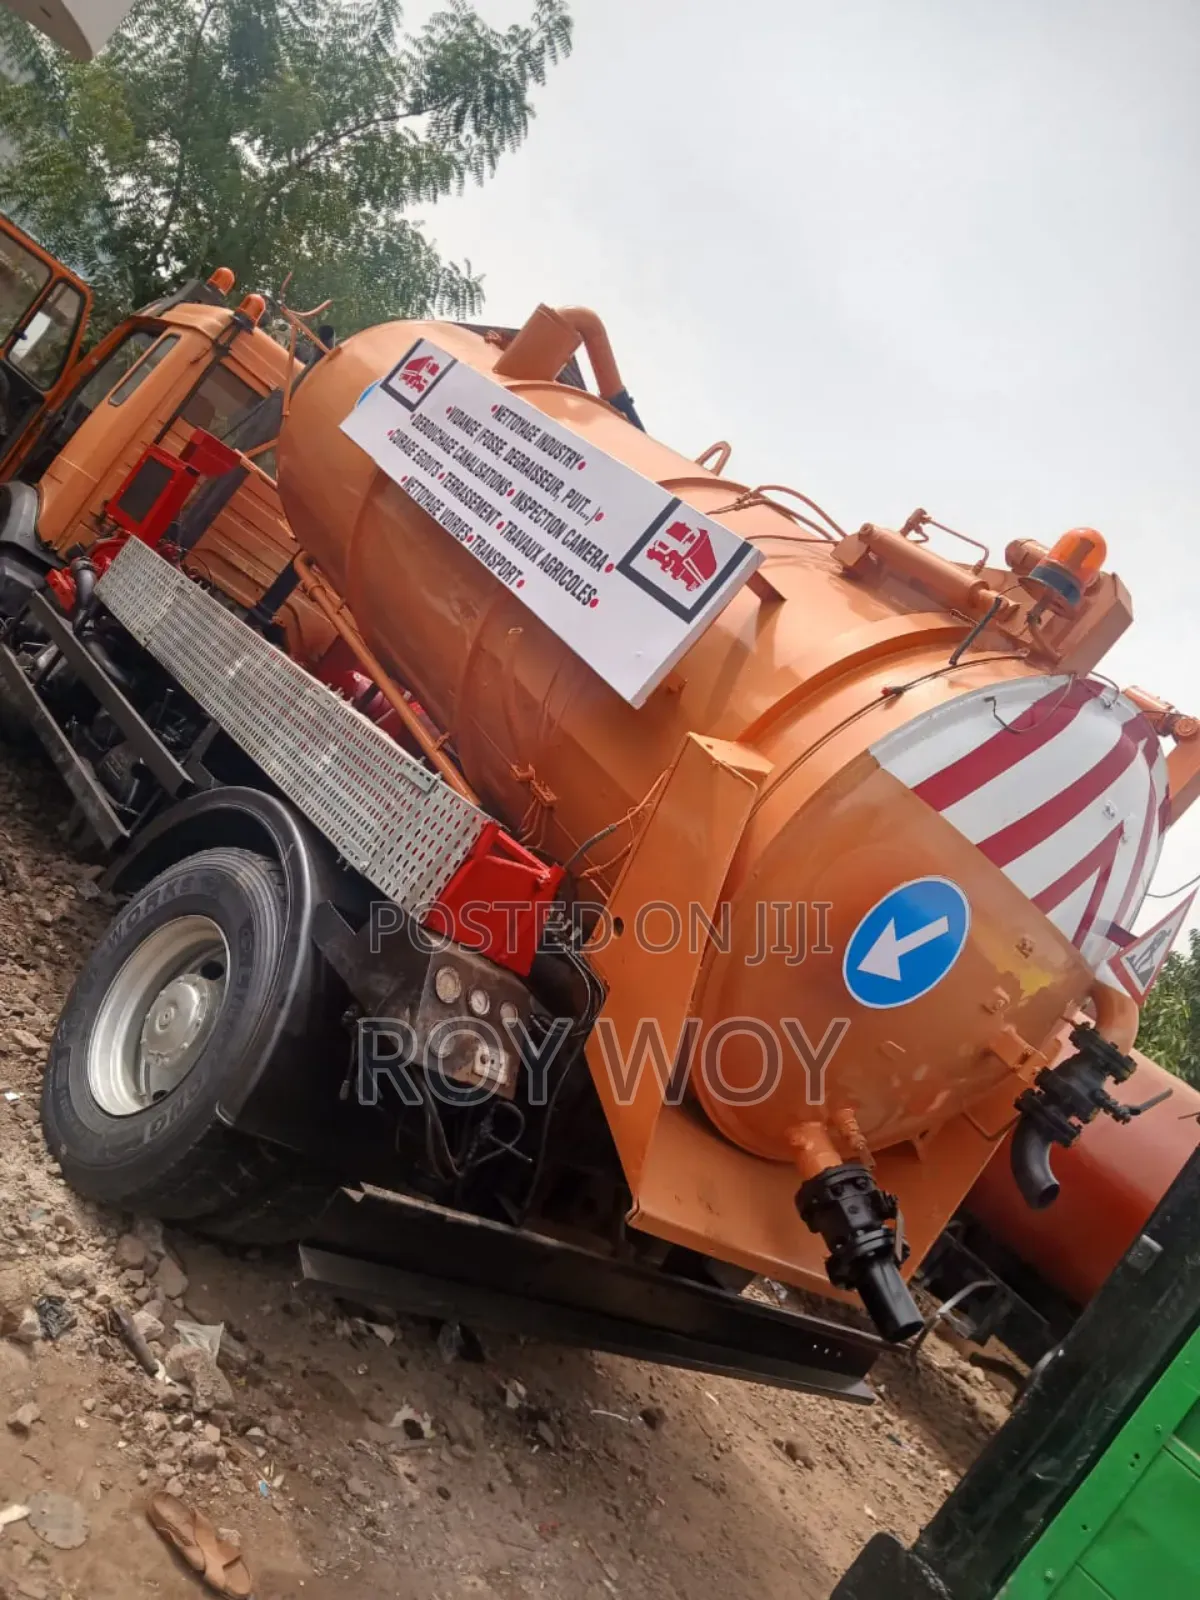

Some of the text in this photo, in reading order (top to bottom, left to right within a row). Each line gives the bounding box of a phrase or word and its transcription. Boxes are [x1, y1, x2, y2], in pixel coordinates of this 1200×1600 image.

[446, 405, 482, 437] VIDANGE
[492, 404, 584, 470] NETTOYAGE INDUSTRY
[389, 428, 597, 606] CURAGE EGOUTS TERRASSEMENT TRAVAUX AGRICOLES
[402, 476, 524, 586] NETTOYAGE VOIRIES TRANSPORT
[411, 413, 609, 572] DEBOUCHAGE CANALISATIONS INSPECTION CAMERA
